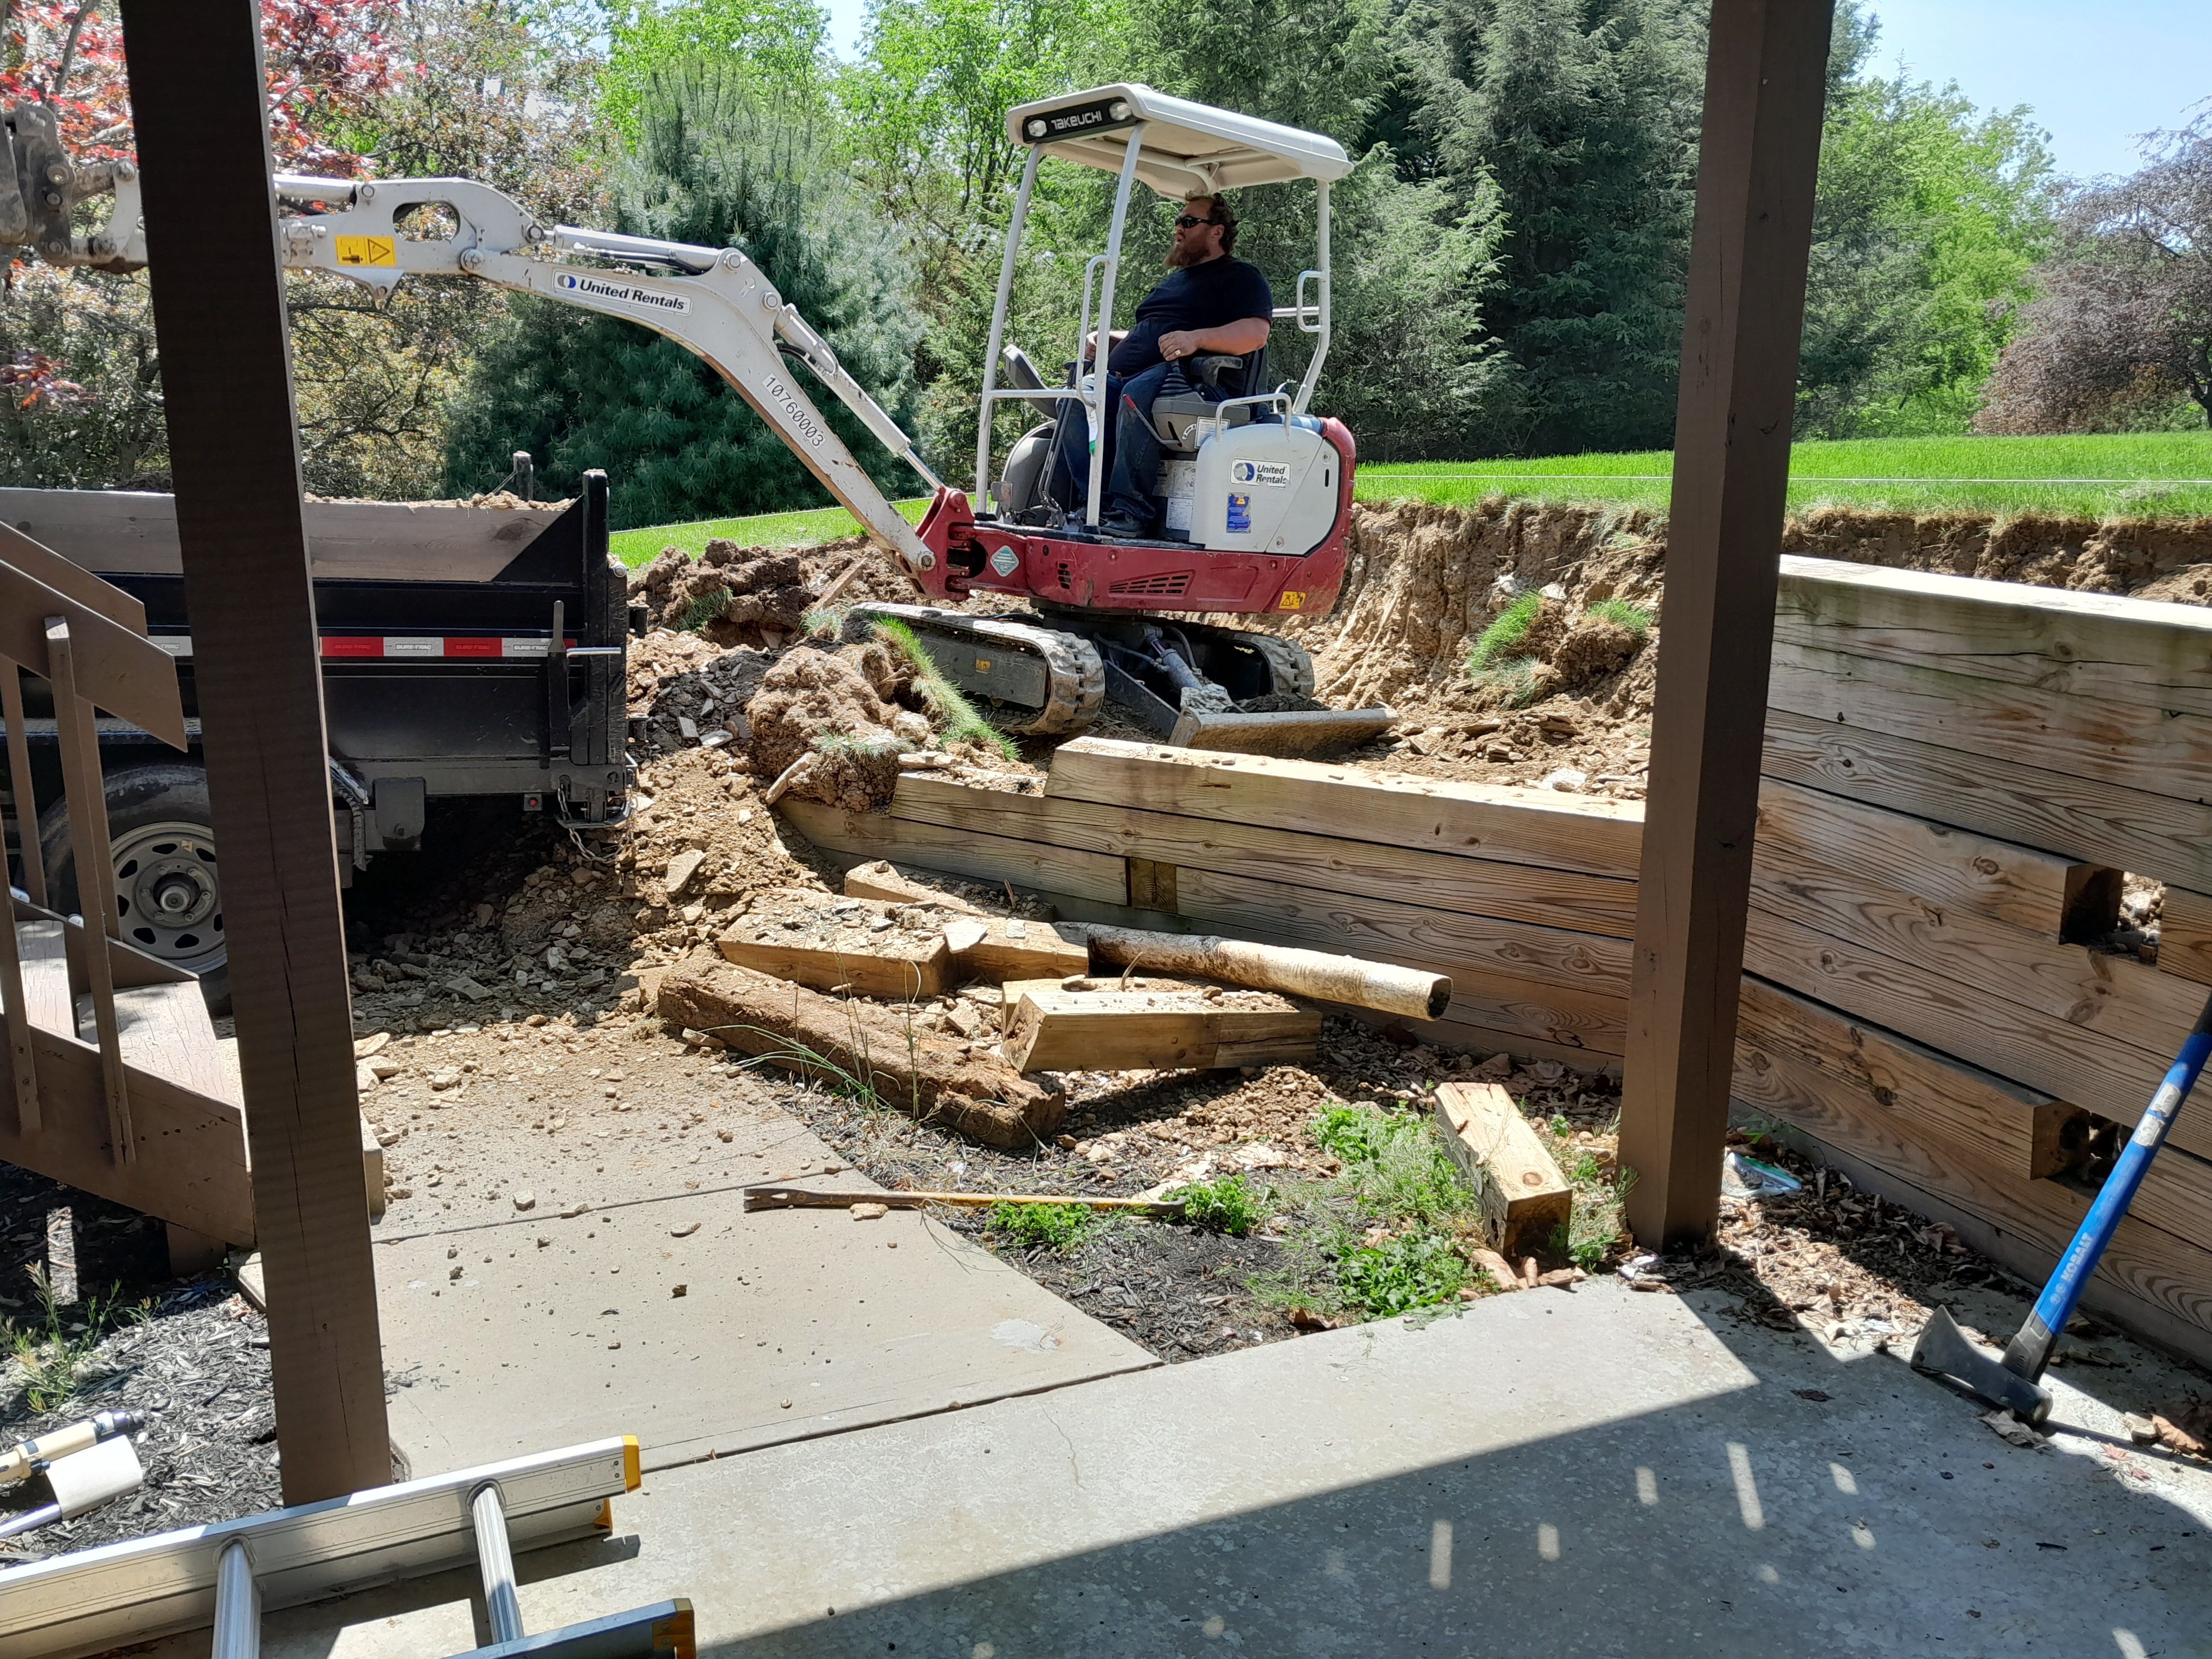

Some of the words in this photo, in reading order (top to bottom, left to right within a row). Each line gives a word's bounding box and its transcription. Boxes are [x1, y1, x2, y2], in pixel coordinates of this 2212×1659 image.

[580, 279, 629, 299] United
[632, 290, 685, 310] Rentals
[766, 377, 824, 446] 10760003
[1257, 465, 1285, 474] United
[2061, 1232, 2092, 1282] KOBALT
